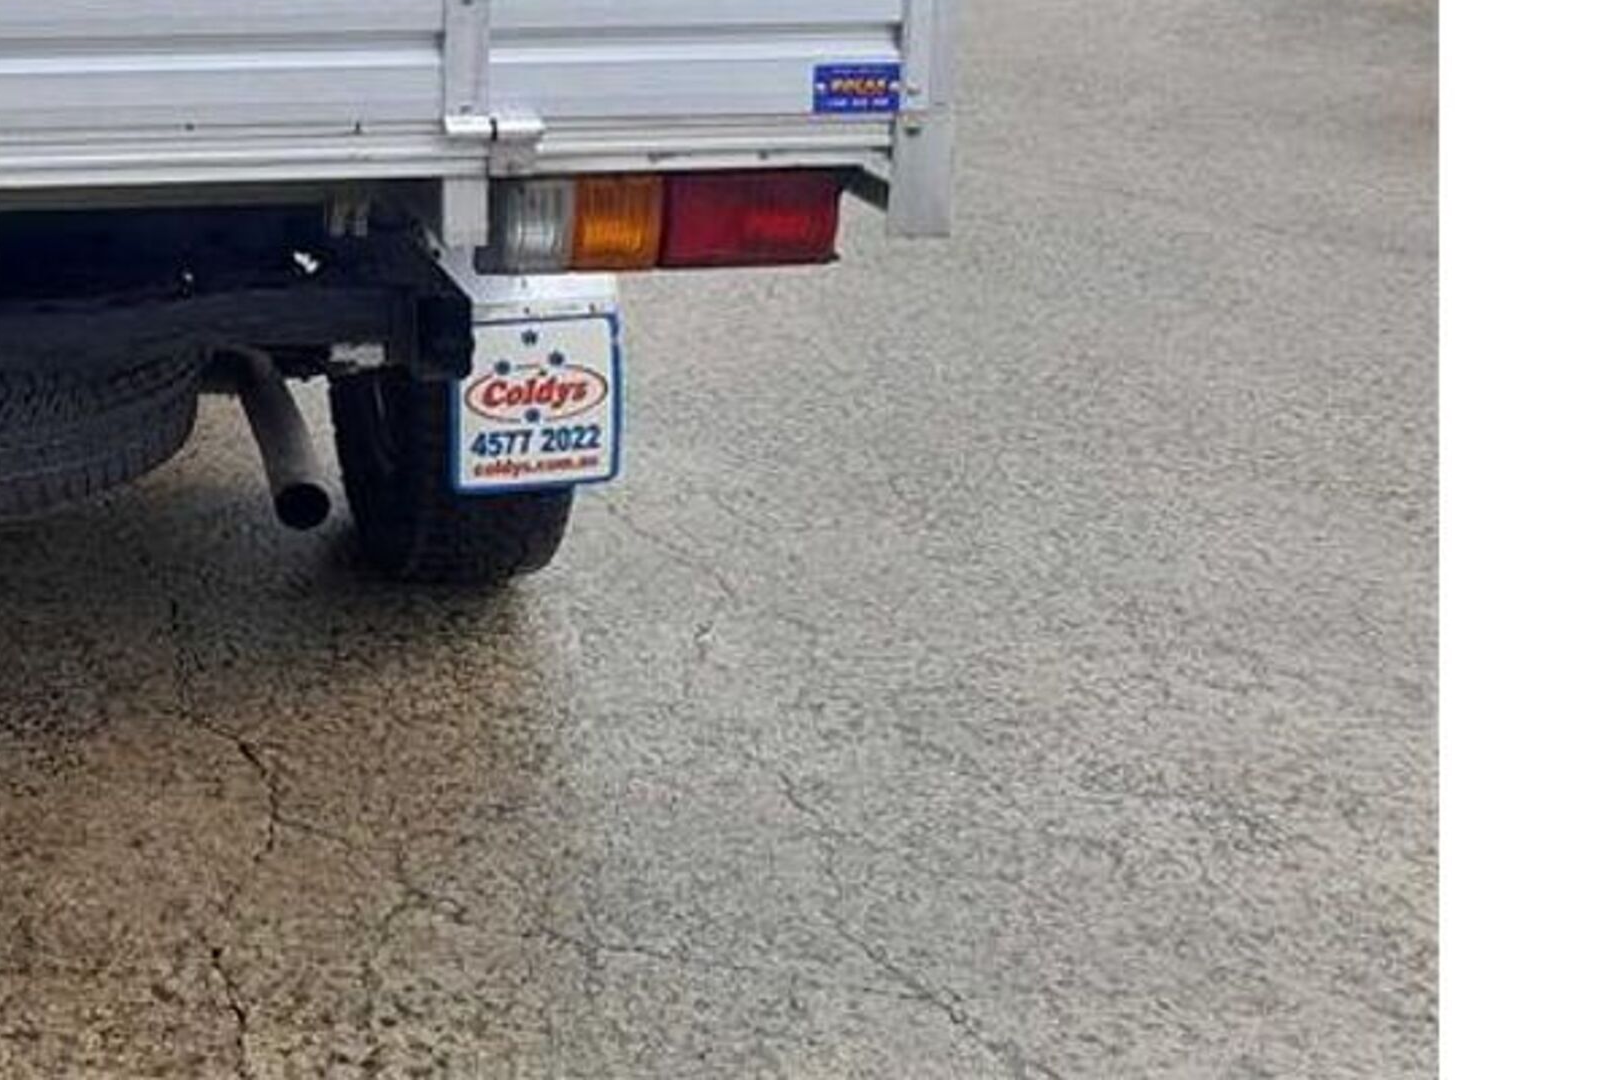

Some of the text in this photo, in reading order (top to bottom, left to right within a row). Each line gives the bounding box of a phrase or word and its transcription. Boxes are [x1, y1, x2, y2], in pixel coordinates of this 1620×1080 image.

[482, 376, 589, 409] Coldys
[470, 424, 602, 457] 4577 2022
